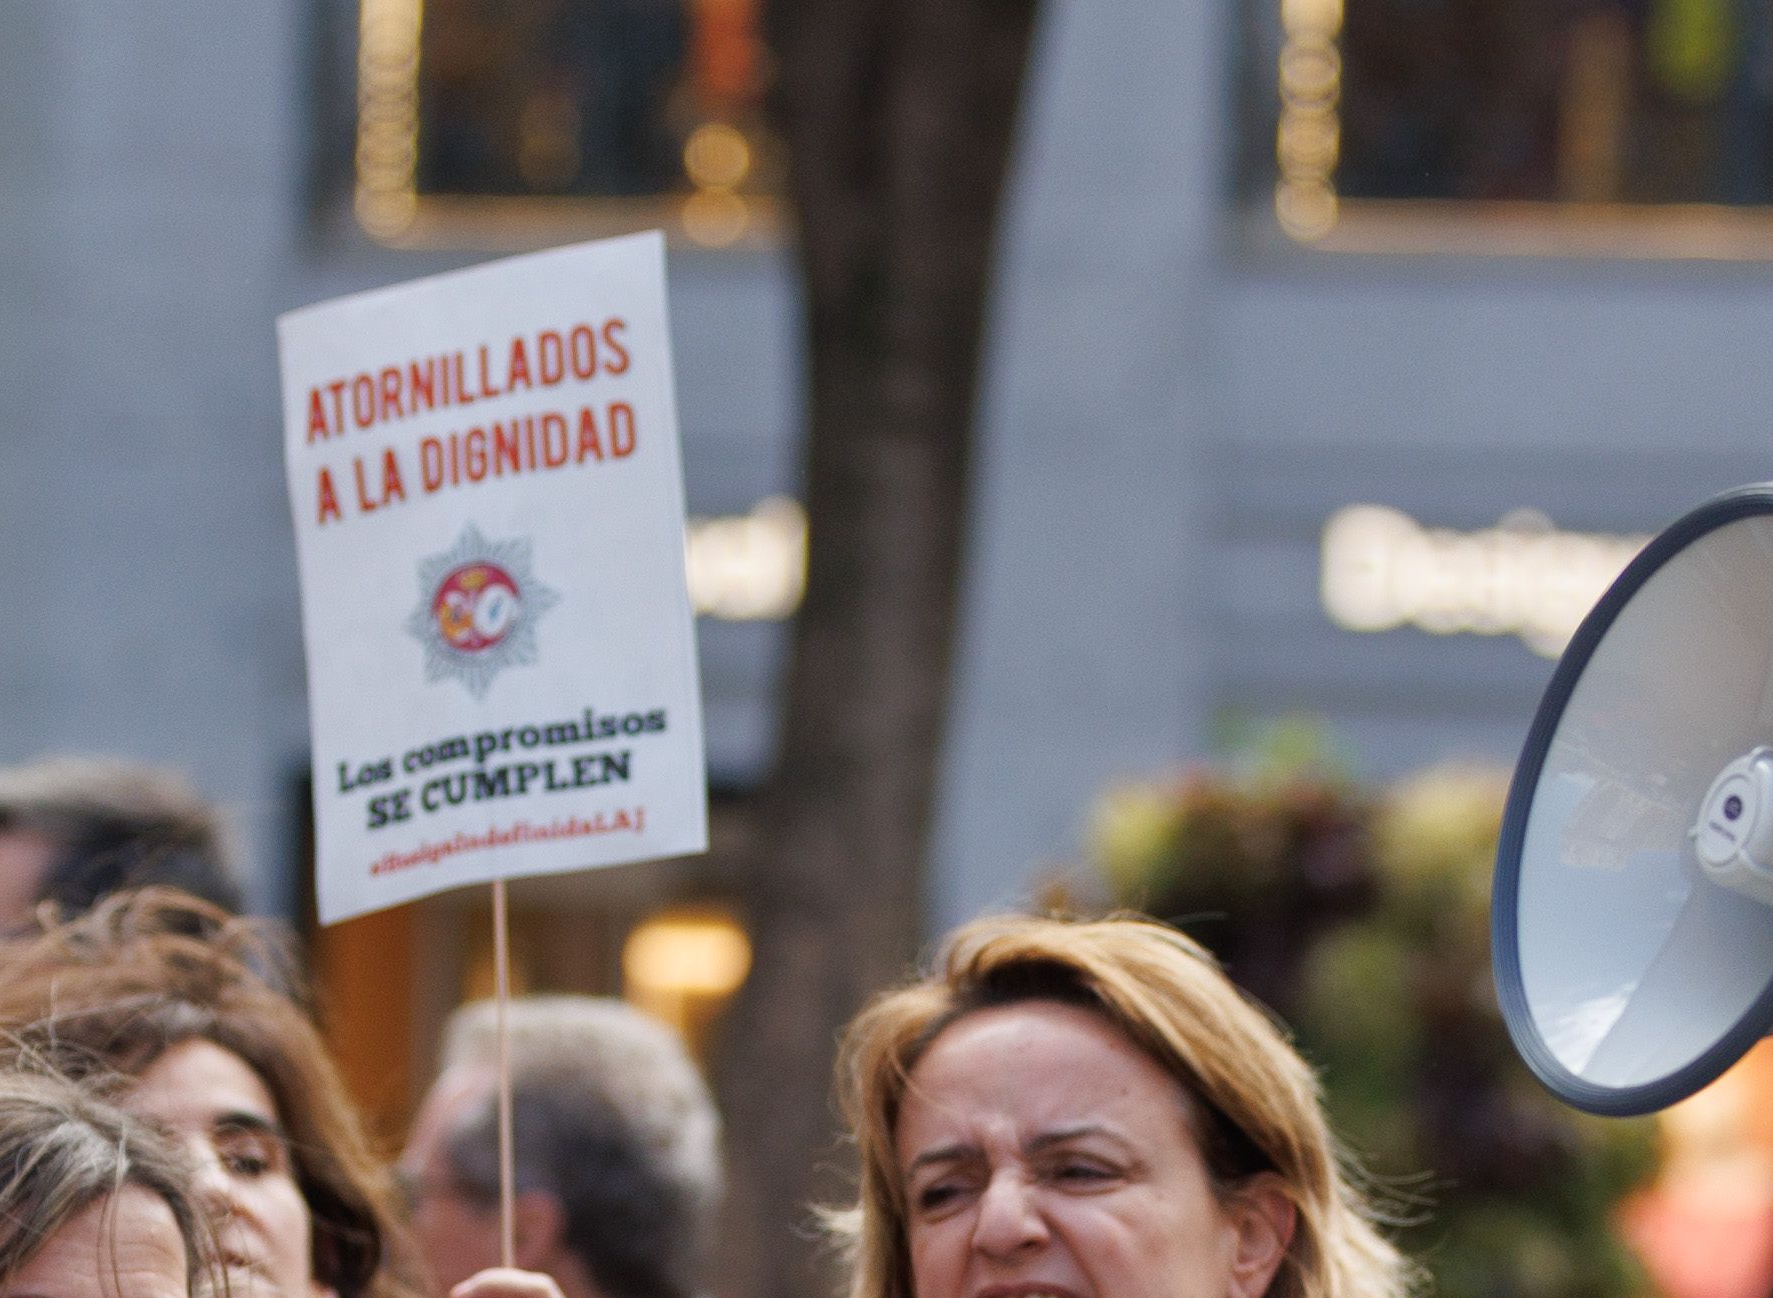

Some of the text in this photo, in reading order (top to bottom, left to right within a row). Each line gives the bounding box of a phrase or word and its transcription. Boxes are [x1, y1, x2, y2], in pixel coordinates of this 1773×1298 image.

[306, 319, 630, 444] ATORNILLADOS
[317, 401, 638, 525] A LA DIGNIDAD
[337, 706, 667, 793] Los compromisos
[367, 750, 632, 829] SE CUMPLEN
